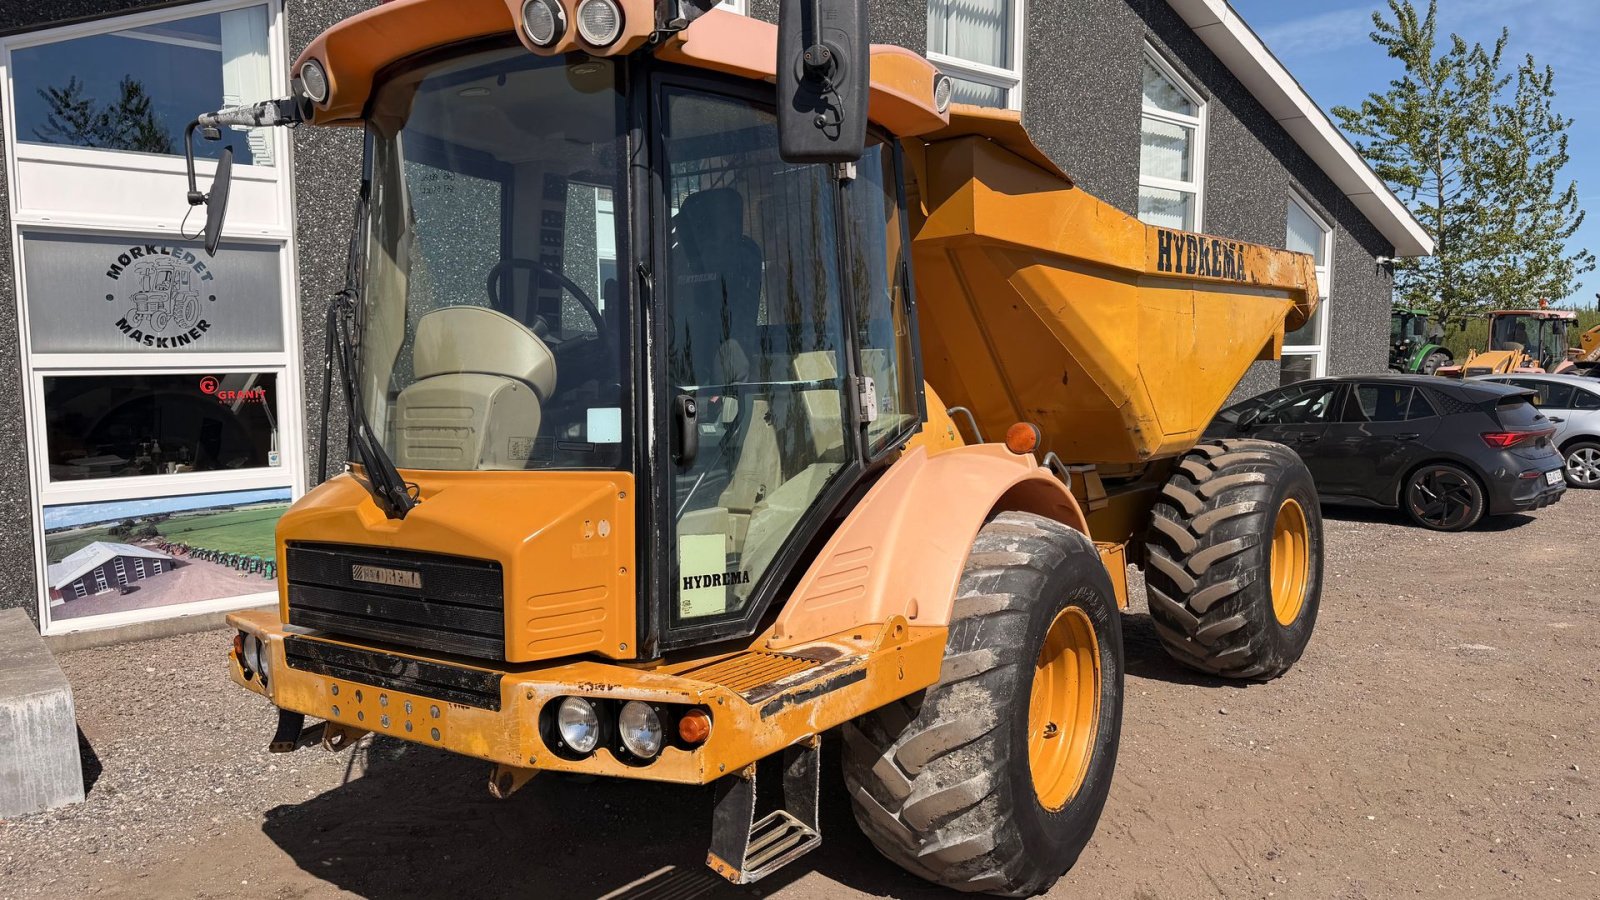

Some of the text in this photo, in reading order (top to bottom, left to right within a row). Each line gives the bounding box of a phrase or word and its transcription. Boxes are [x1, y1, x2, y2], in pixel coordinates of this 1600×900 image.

[106, 244, 214, 281] MØRKLEDET
[1157, 229, 1247, 281] HYDREMA
[115, 317, 211, 348] MASKINER
[217, 390, 266, 400] GRANIT
[682, 570, 750, 590] HYDREMA
